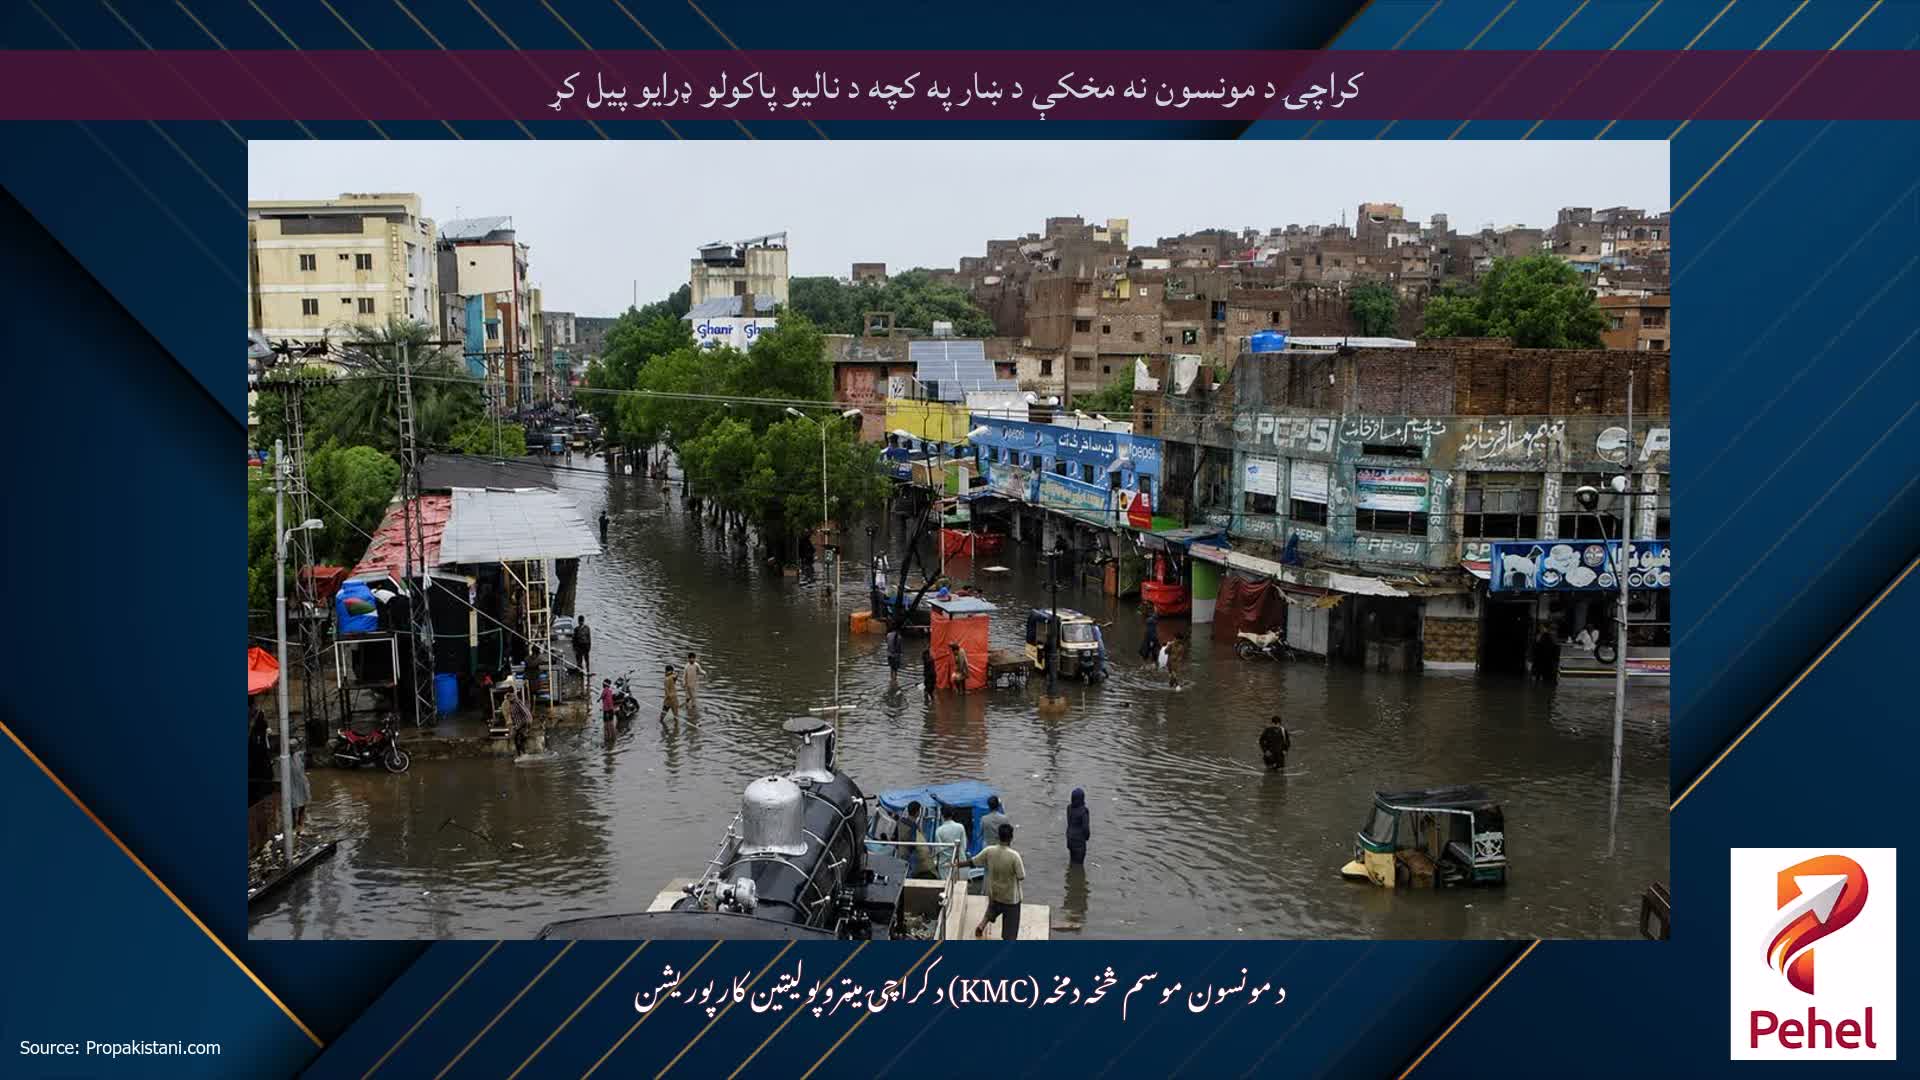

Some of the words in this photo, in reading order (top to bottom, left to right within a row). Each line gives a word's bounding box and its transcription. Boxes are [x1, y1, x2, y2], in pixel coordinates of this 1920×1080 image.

[697, 319, 734, 339] Ghani
[1255, 412, 1337, 454] PEPSI
[1368, 538, 1421, 555] PEPSI
